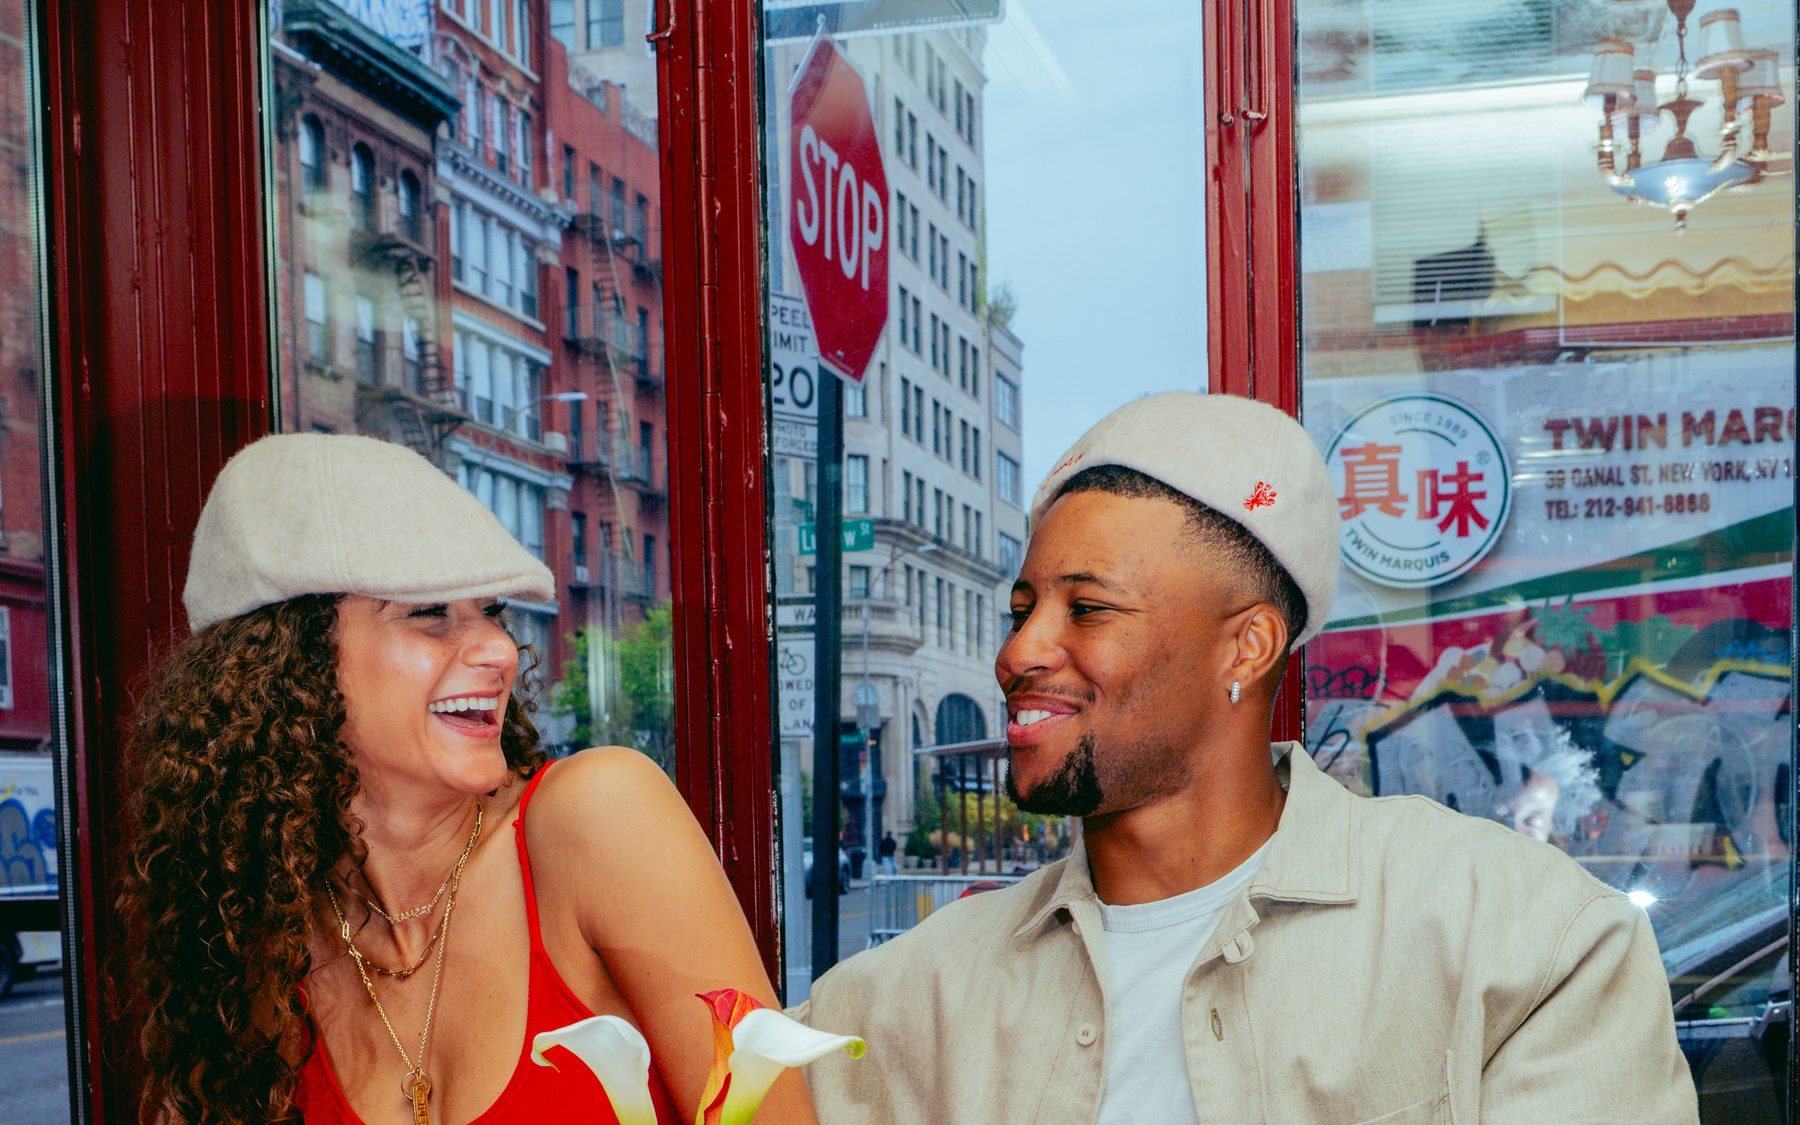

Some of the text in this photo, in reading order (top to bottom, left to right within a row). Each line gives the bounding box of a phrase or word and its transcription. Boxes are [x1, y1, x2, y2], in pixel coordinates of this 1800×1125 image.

[797, 124, 883, 291] STOP
[773, 331, 808, 354] IMIT
[1389, 412, 1432, 426] SINCE
[1543, 411, 1667, 452] TWIN
[1337, 443, 1490, 538] 真味
[1571, 465, 1625, 487] CANAL
[1659, 462, 1694, 483] NEW
[1702, 460, 1751, 482] YORK,
[1345, 527, 1450, 572] TWIN MARQUIS
